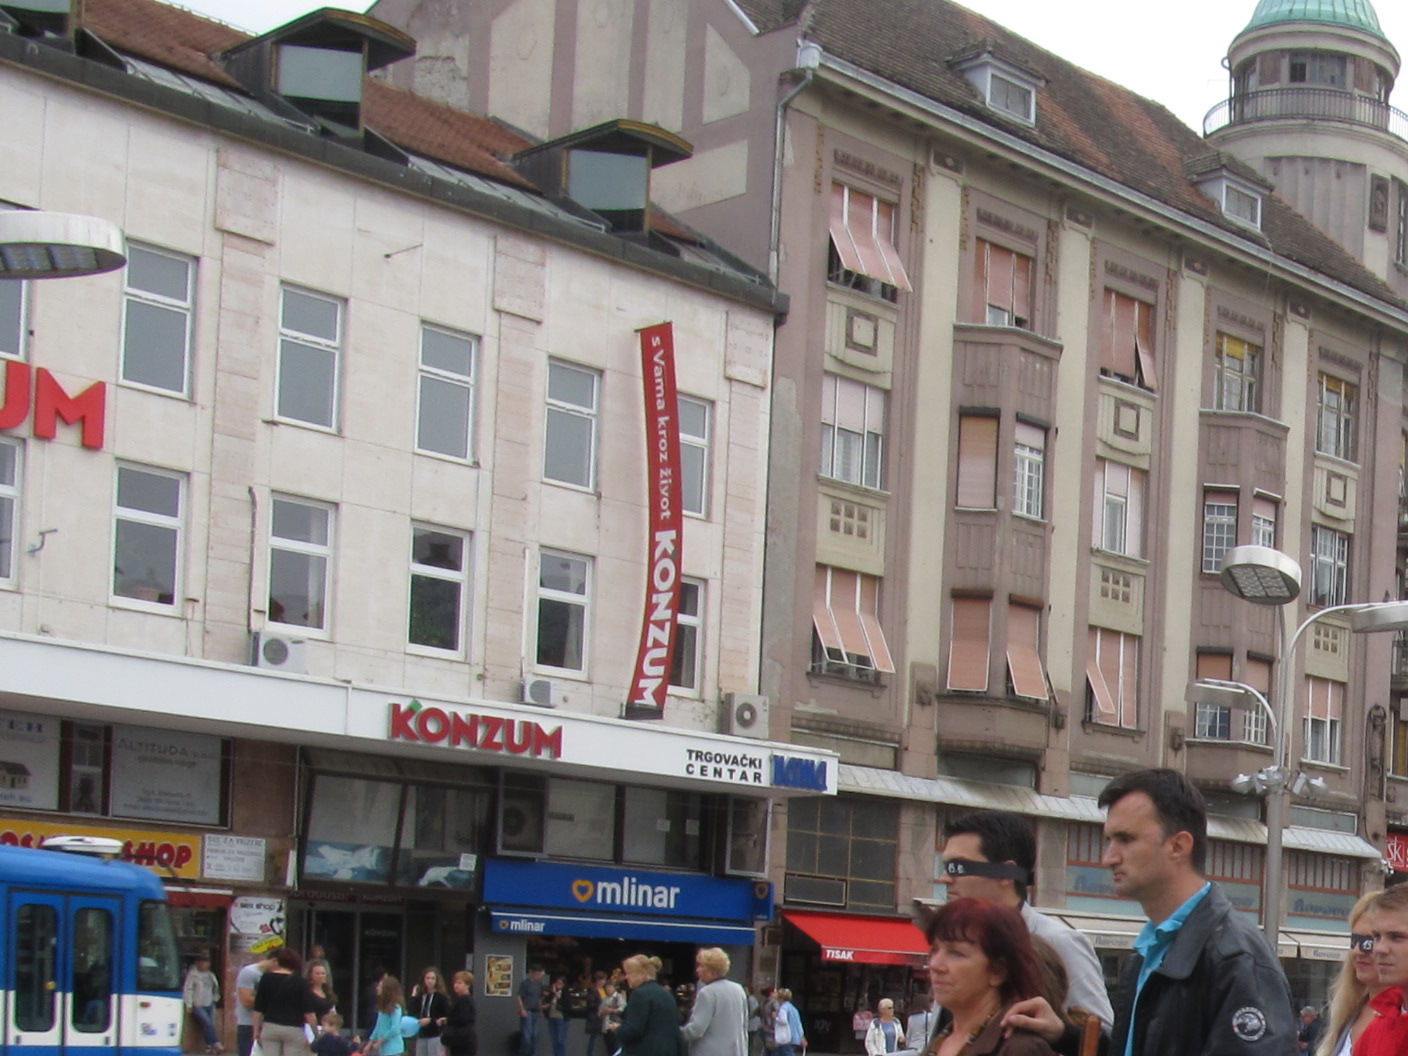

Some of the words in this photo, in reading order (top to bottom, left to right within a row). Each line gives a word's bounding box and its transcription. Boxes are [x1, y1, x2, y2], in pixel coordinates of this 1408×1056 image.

[651, 336, 661, 347] s
[652, 350, 666, 411] Vama
[657, 416, 671, 463] kroz
[659, 470, 673, 521] život
[634, 529, 678, 708] KONZUM
[388, 699, 563, 759] KONZUM
[685, 763, 763, 784] CENTAR
[686, 748, 763, 770] TRGOVAČKI
[122, 840, 193, 869] SHOP
[596, 876, 681, 909] mlinar
[510, 918, 545, 933] mlinar
[825, 949, 855, 960] TISAK
